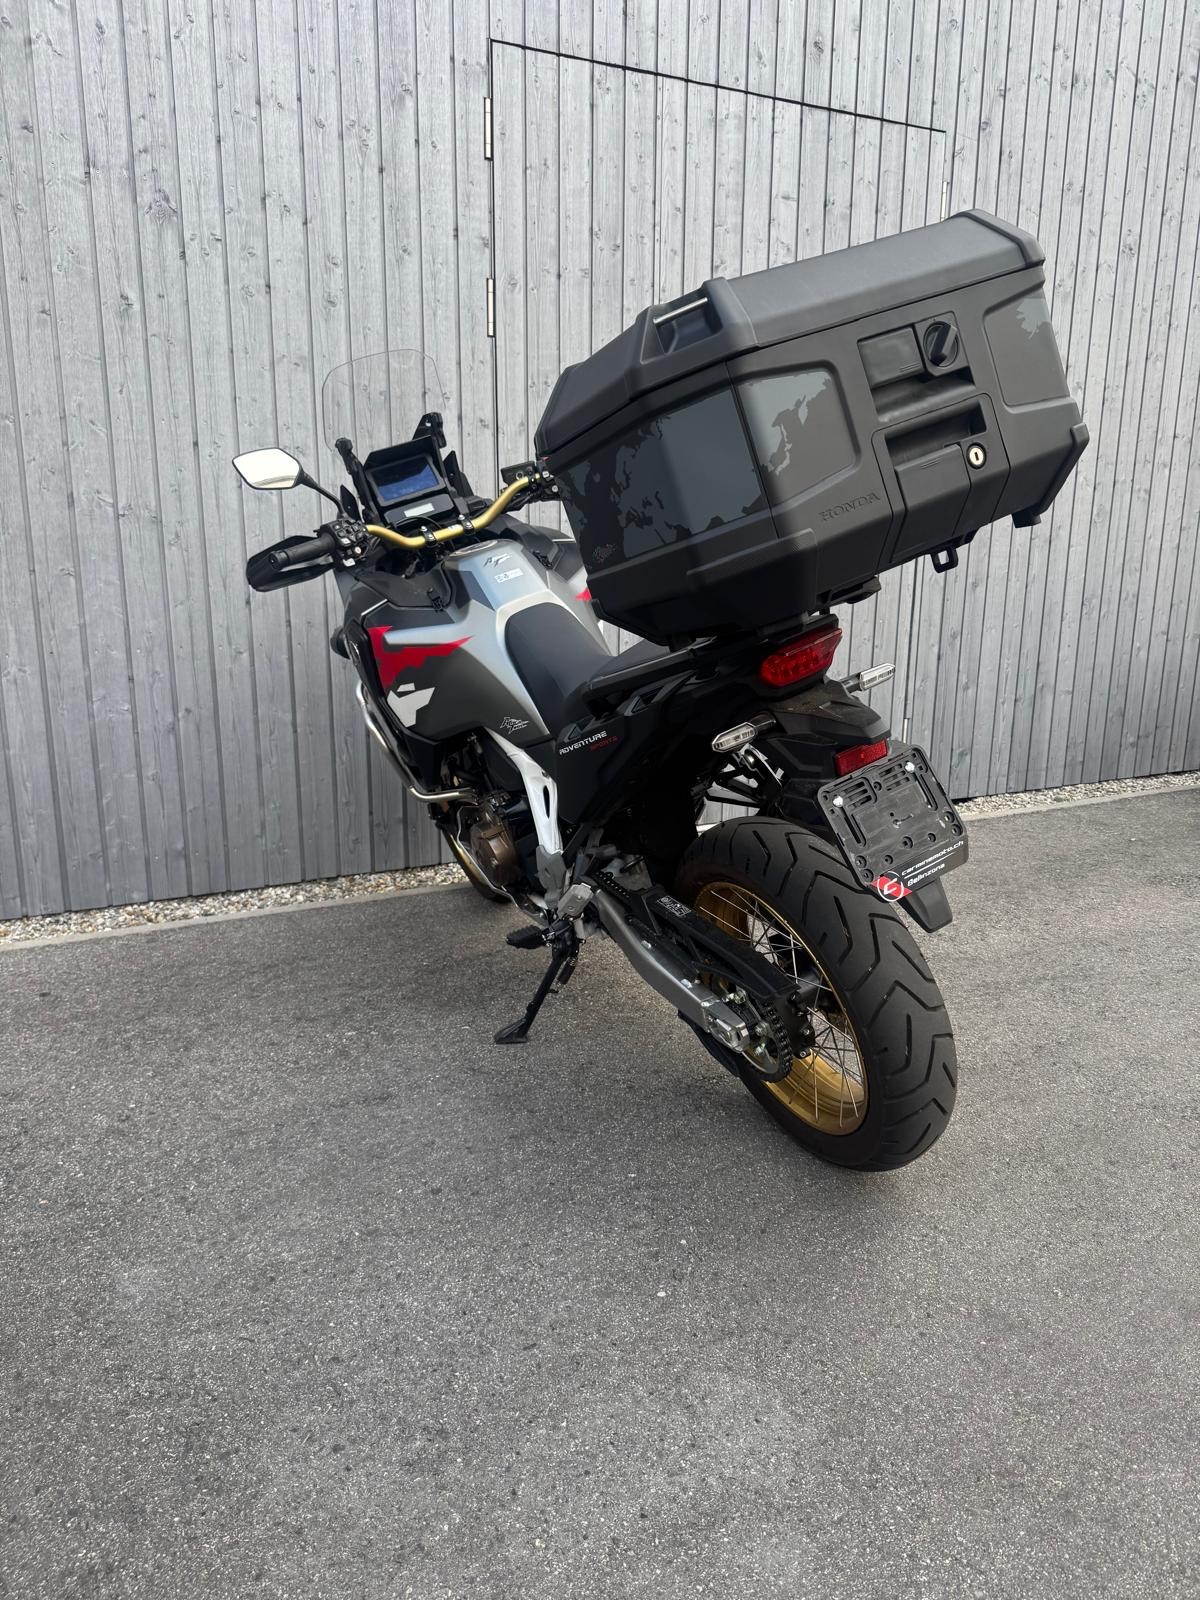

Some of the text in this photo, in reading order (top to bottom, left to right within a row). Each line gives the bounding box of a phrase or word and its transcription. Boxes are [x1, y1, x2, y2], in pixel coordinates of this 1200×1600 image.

[818, 492, 881, 521] HONDA
[559, 730, 607, 755] ADVENTURE
[907, 863, 945, 887] Bellinzona
